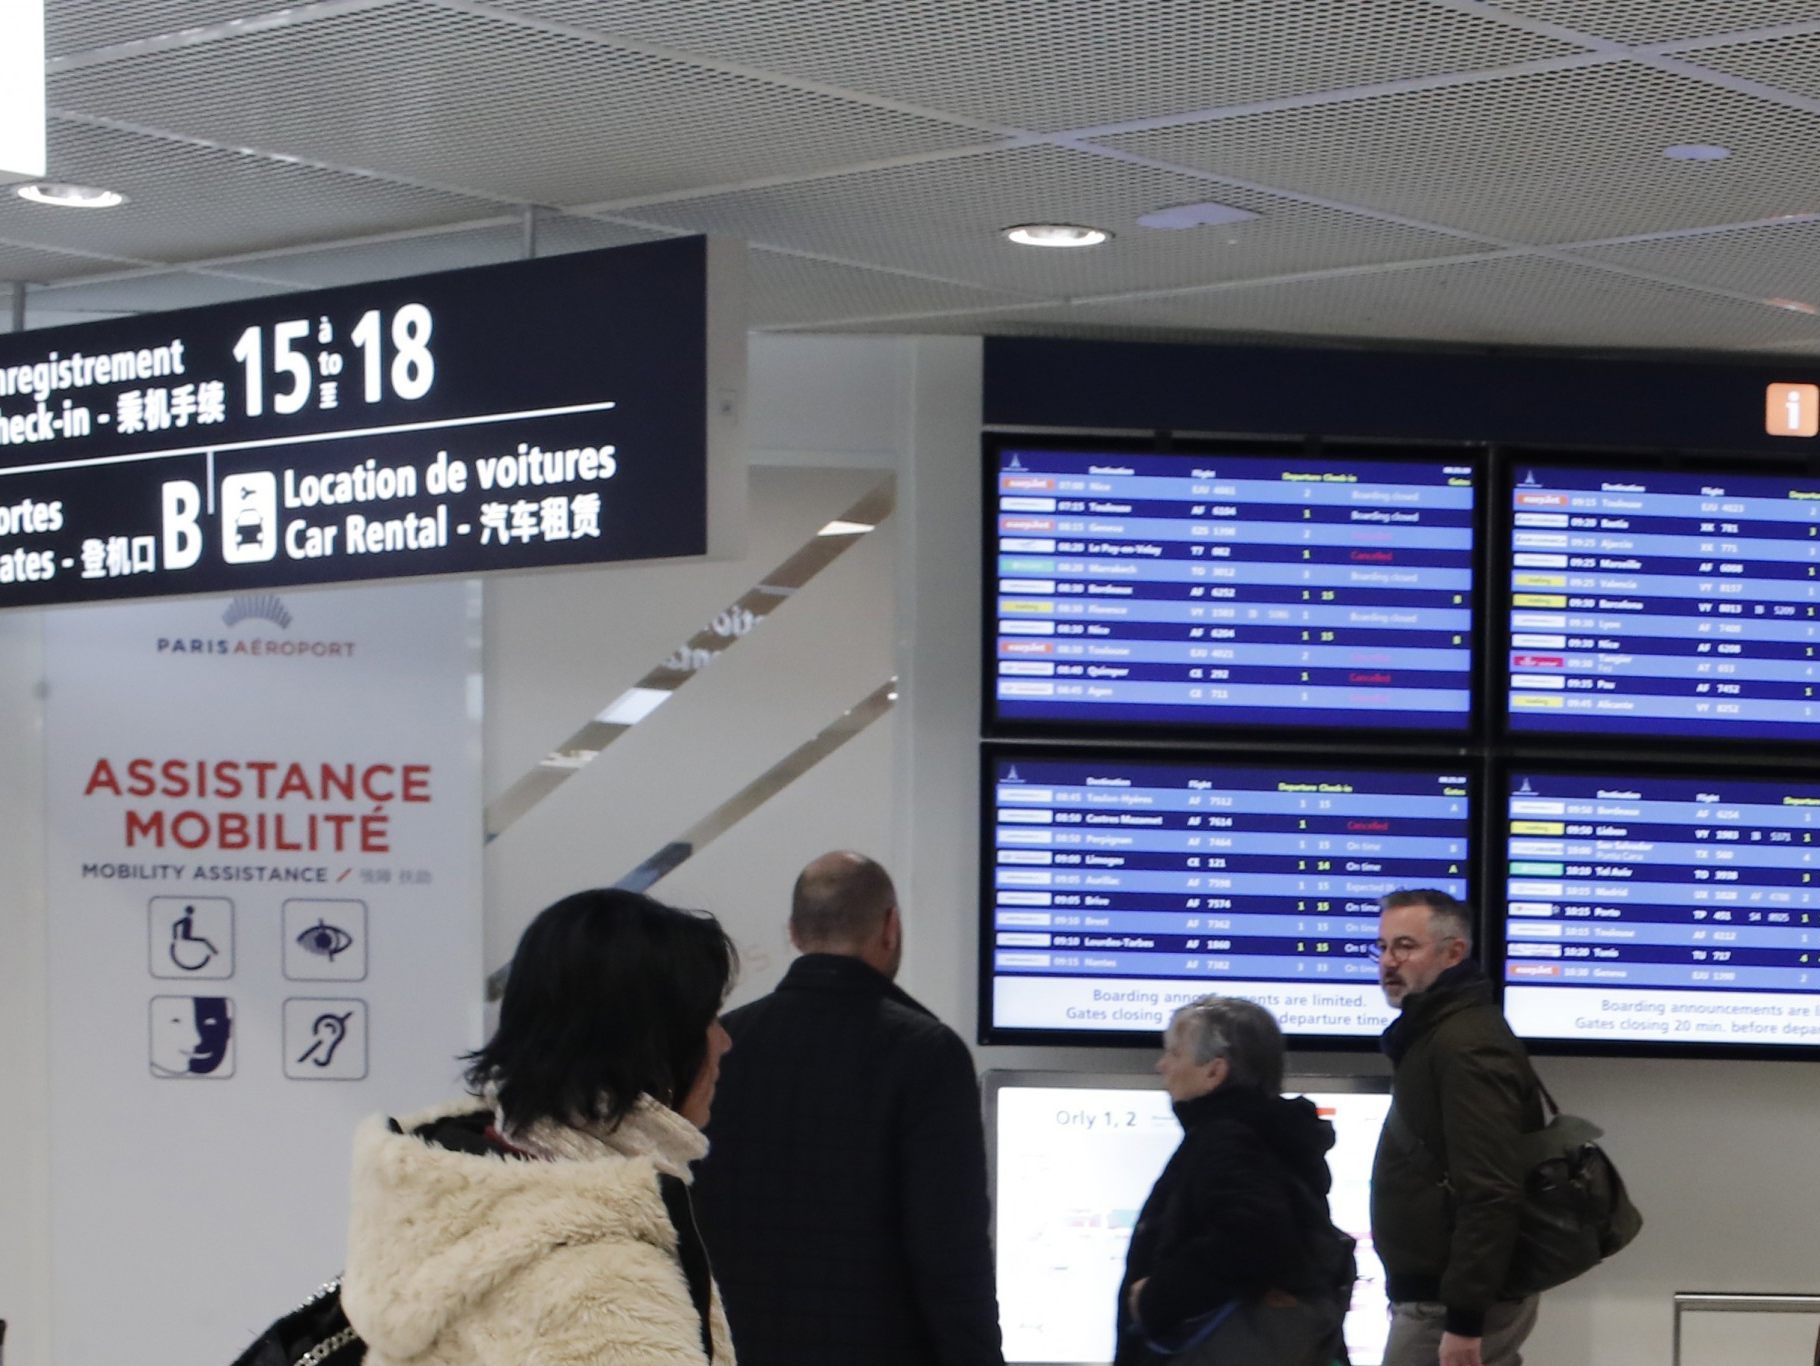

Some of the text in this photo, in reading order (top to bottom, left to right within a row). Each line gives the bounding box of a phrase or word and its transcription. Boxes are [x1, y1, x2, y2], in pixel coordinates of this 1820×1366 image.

[233, 319, 312, 417] 15
[318, 350, 343, 376] to
[351, 303, 435, 404] 18
[284, 443, 616, 509] Location de voitures
[162, 480, 203, 571] B
[285, 519, 338, 560] Car
[346, 504, 448, 555] Rental
[479, 492, 602, 546] 汽车租赁
[83, 758, 434, 803] ASSISTANCE
[125, 805, 391, 854] MOBILITÉ
[81, 862, 185, 881] MOBILITY
[193, 865, 328, 884] ASSISTANCE
[1093, 989, 1159, 1005] Boarding
[1285, 996, 1307, 1007] are
[1312, 993, 1367, 1008] limited.
[1601, 1000, 1665, 1015] Boarding
[1670, 1001, 1783, 1017] announcements
[1788, 1007, 1810, 1017] are
[1066, 1008, 1107, 1020] Gates
[1112, 1009, 1163, 1022] closing
[1279, 1012, 1351, 1030] departure
[1575, 1018, 1615, 1030] Gates
[1620, 1018, 1667, 1032] closing
[1675, 1020, 1691, 1031] 20
[1731, 1020, 1777, 1034] before
[1056, 1110, 1097, 1130] Orly
[1126, 1112, 1137, 1127] 2
